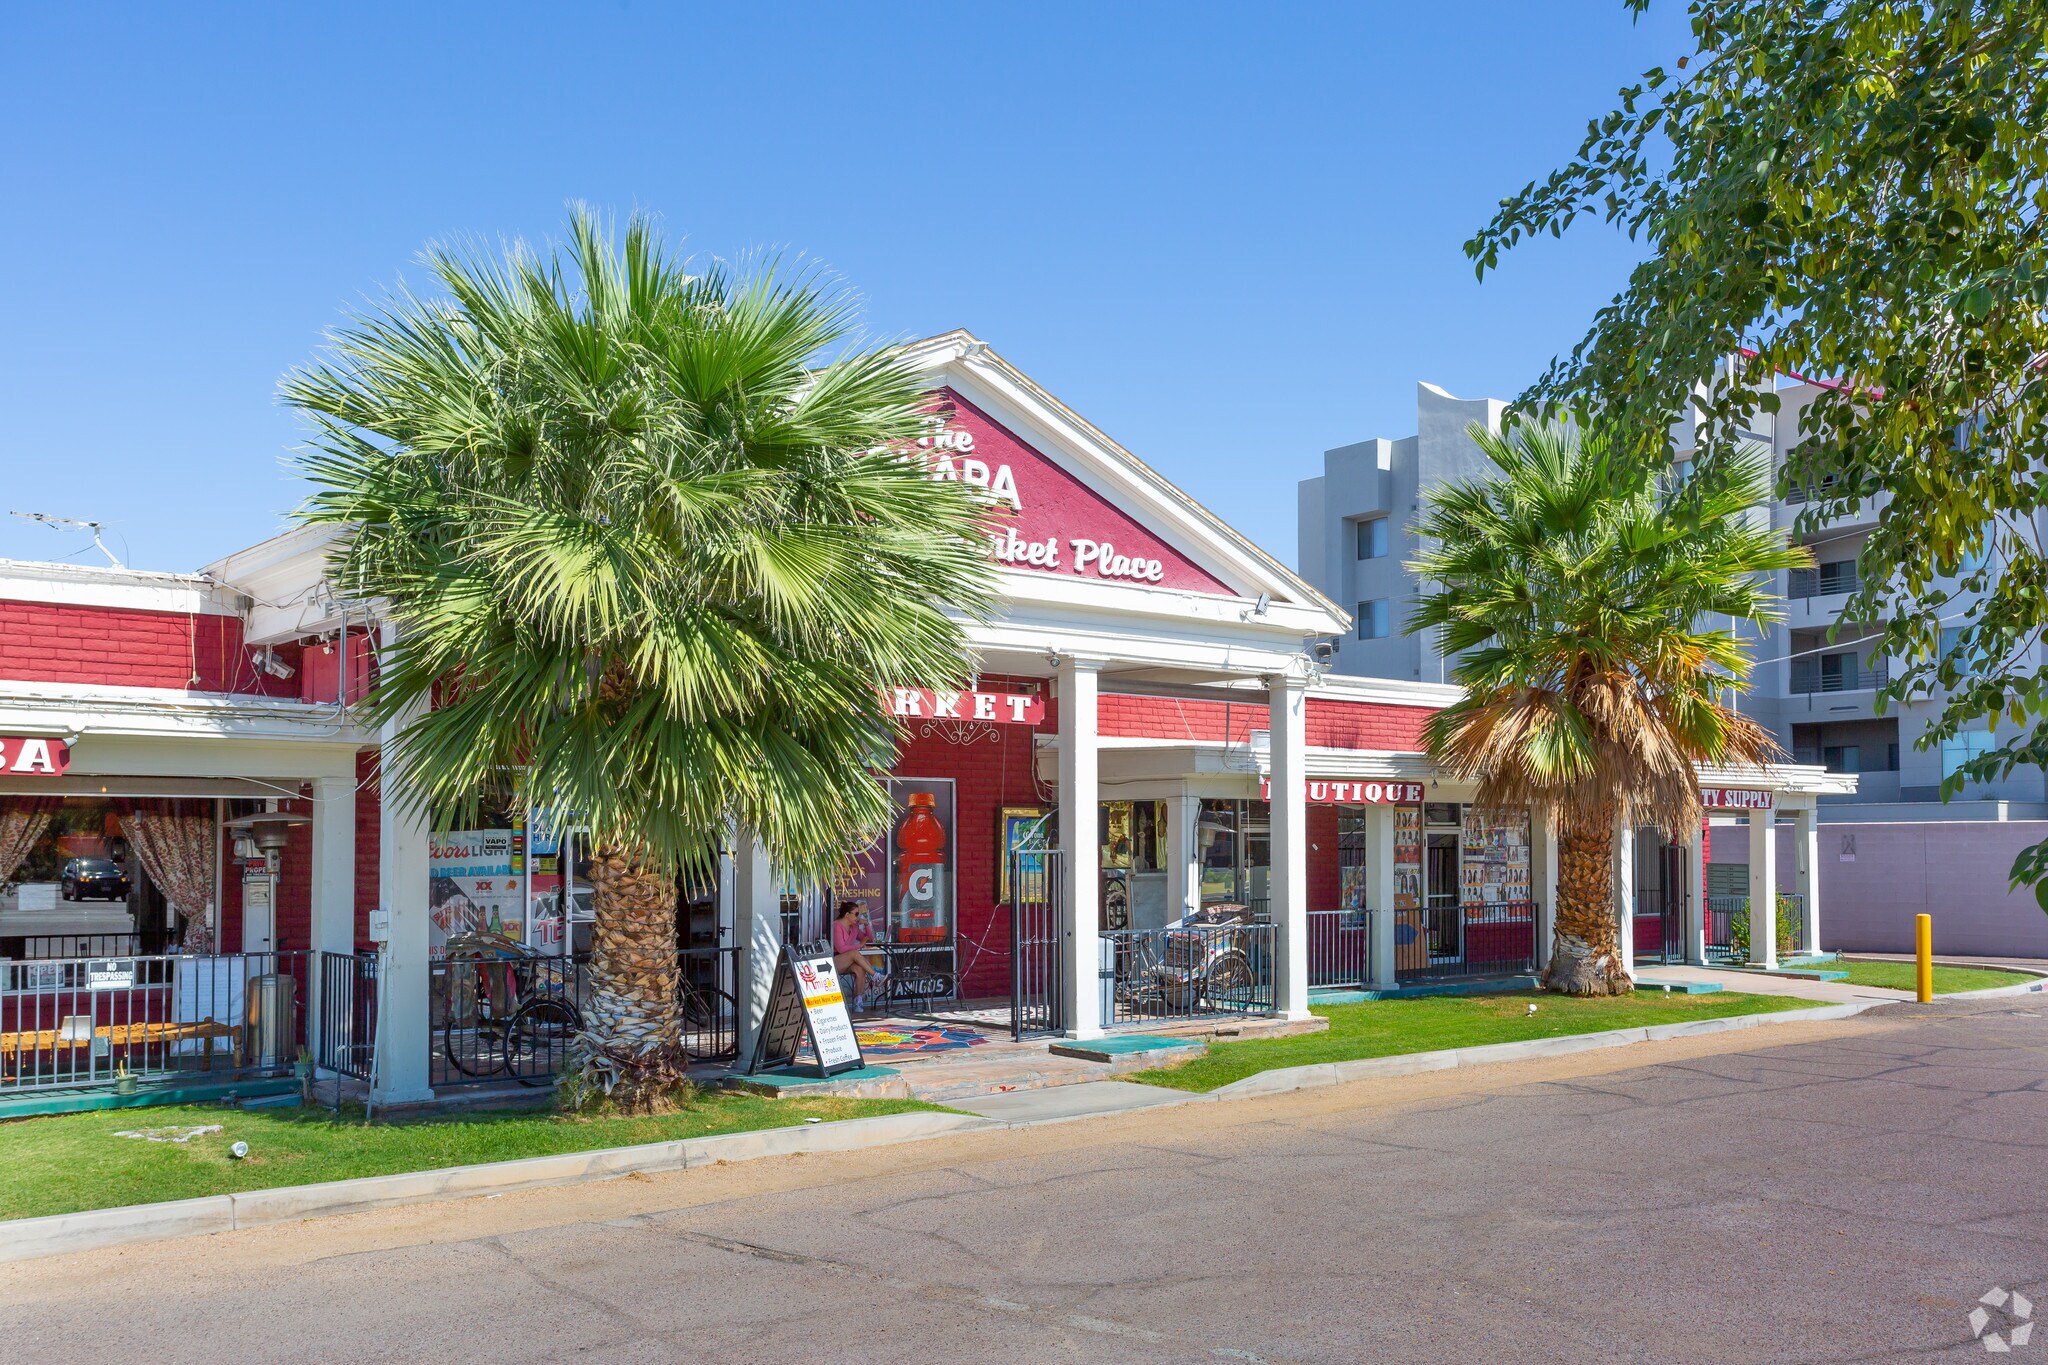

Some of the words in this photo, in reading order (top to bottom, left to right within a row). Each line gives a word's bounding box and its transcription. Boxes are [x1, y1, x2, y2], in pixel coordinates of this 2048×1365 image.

[917, 416, 976, 452] The
[1069, 538, 1164, 581] Place
[893, 689, 1032, 722] RKET
[0, 738, 56, 773] A
[1265, 781, 1421, 803] UTIQUE
[1701, 788, 1720, 807] TY
[1724, 789, 1772, 808] SUPPLY
[533, 833, 557, 842] HRE
[440, 866, 467, 877] BEER
[908, 868, 934, 901] G
[532, 916, 565, 946] TE
[106, 962, 117, 972] NO
[90, 971, 133, 982] TRESPASSING
[895, 978, 944, 997] AMIGOS
[806, 997, 821, 1006] Market
[822, 995, 831, 1004] Now
[831, 994, 842, 1003] Open
[816, 1015, 837, 1026] Cigarettes
[819, 1027, 831, 1036] Dairy
[831, 1023, 848, 1033] Products
[822, 1036, 836, 1046] Frozen
[836, 1033, 847, 1042] Food
[825, 1046, 842, 1056] Produce
[828, 1055, 840, 1064] Fresh
[840, 1053, 853, 1062] Coffee
